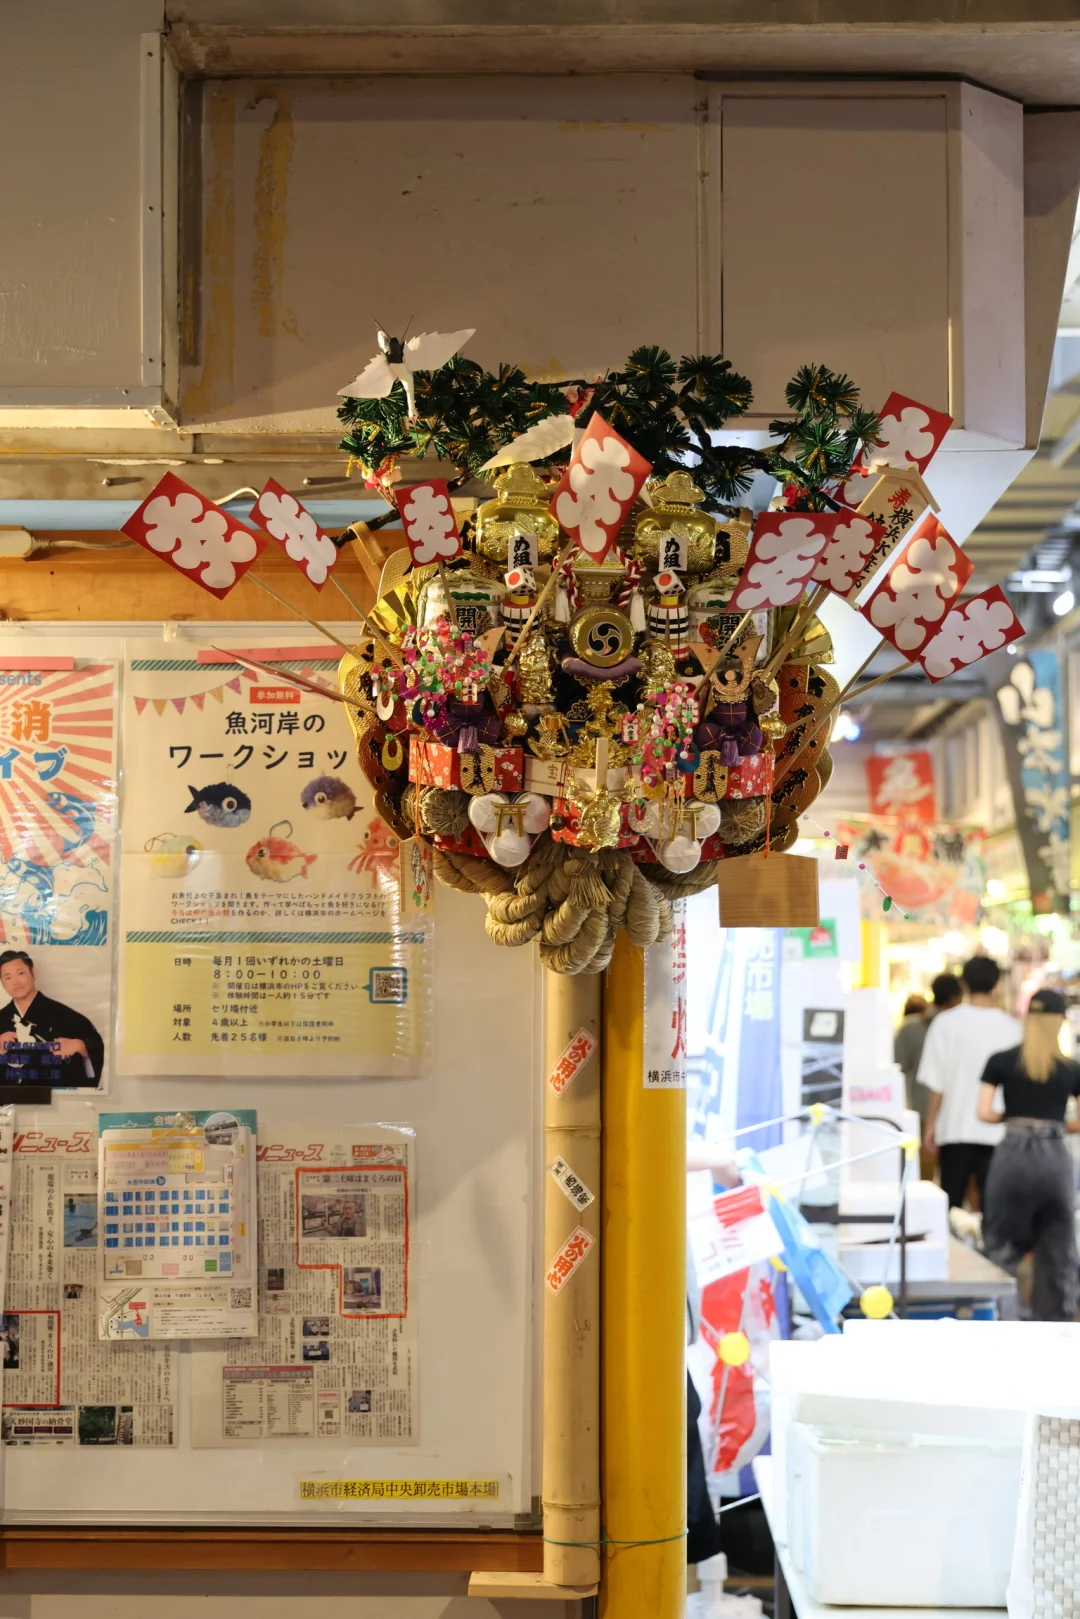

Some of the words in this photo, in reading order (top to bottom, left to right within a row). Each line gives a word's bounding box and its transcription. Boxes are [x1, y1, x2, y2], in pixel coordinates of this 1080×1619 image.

[513, 536, 532, 568] め組
[663, 537, 681, 569] め組
[256, 690, 295, 700] 参加無料
[225, 710, 325, 735] 魚河岸の
[169, 744, 348, 770] ワークショッ
[174, 958, 192, 967] 日時
[173, 1004, 192, 1014] 場所
[212, 1004, 258, 1014] セリ場付近
[173, 1017, 191, 1027] 対象
[173, 1032, 191, 1042] 人数
[549, 1035, 592, 1091] 火の用心
[547, 1233, 590, 1290] 火の用心
[301, 1481, 498, 1498] 横浜市経済局中央卸売市場本場
